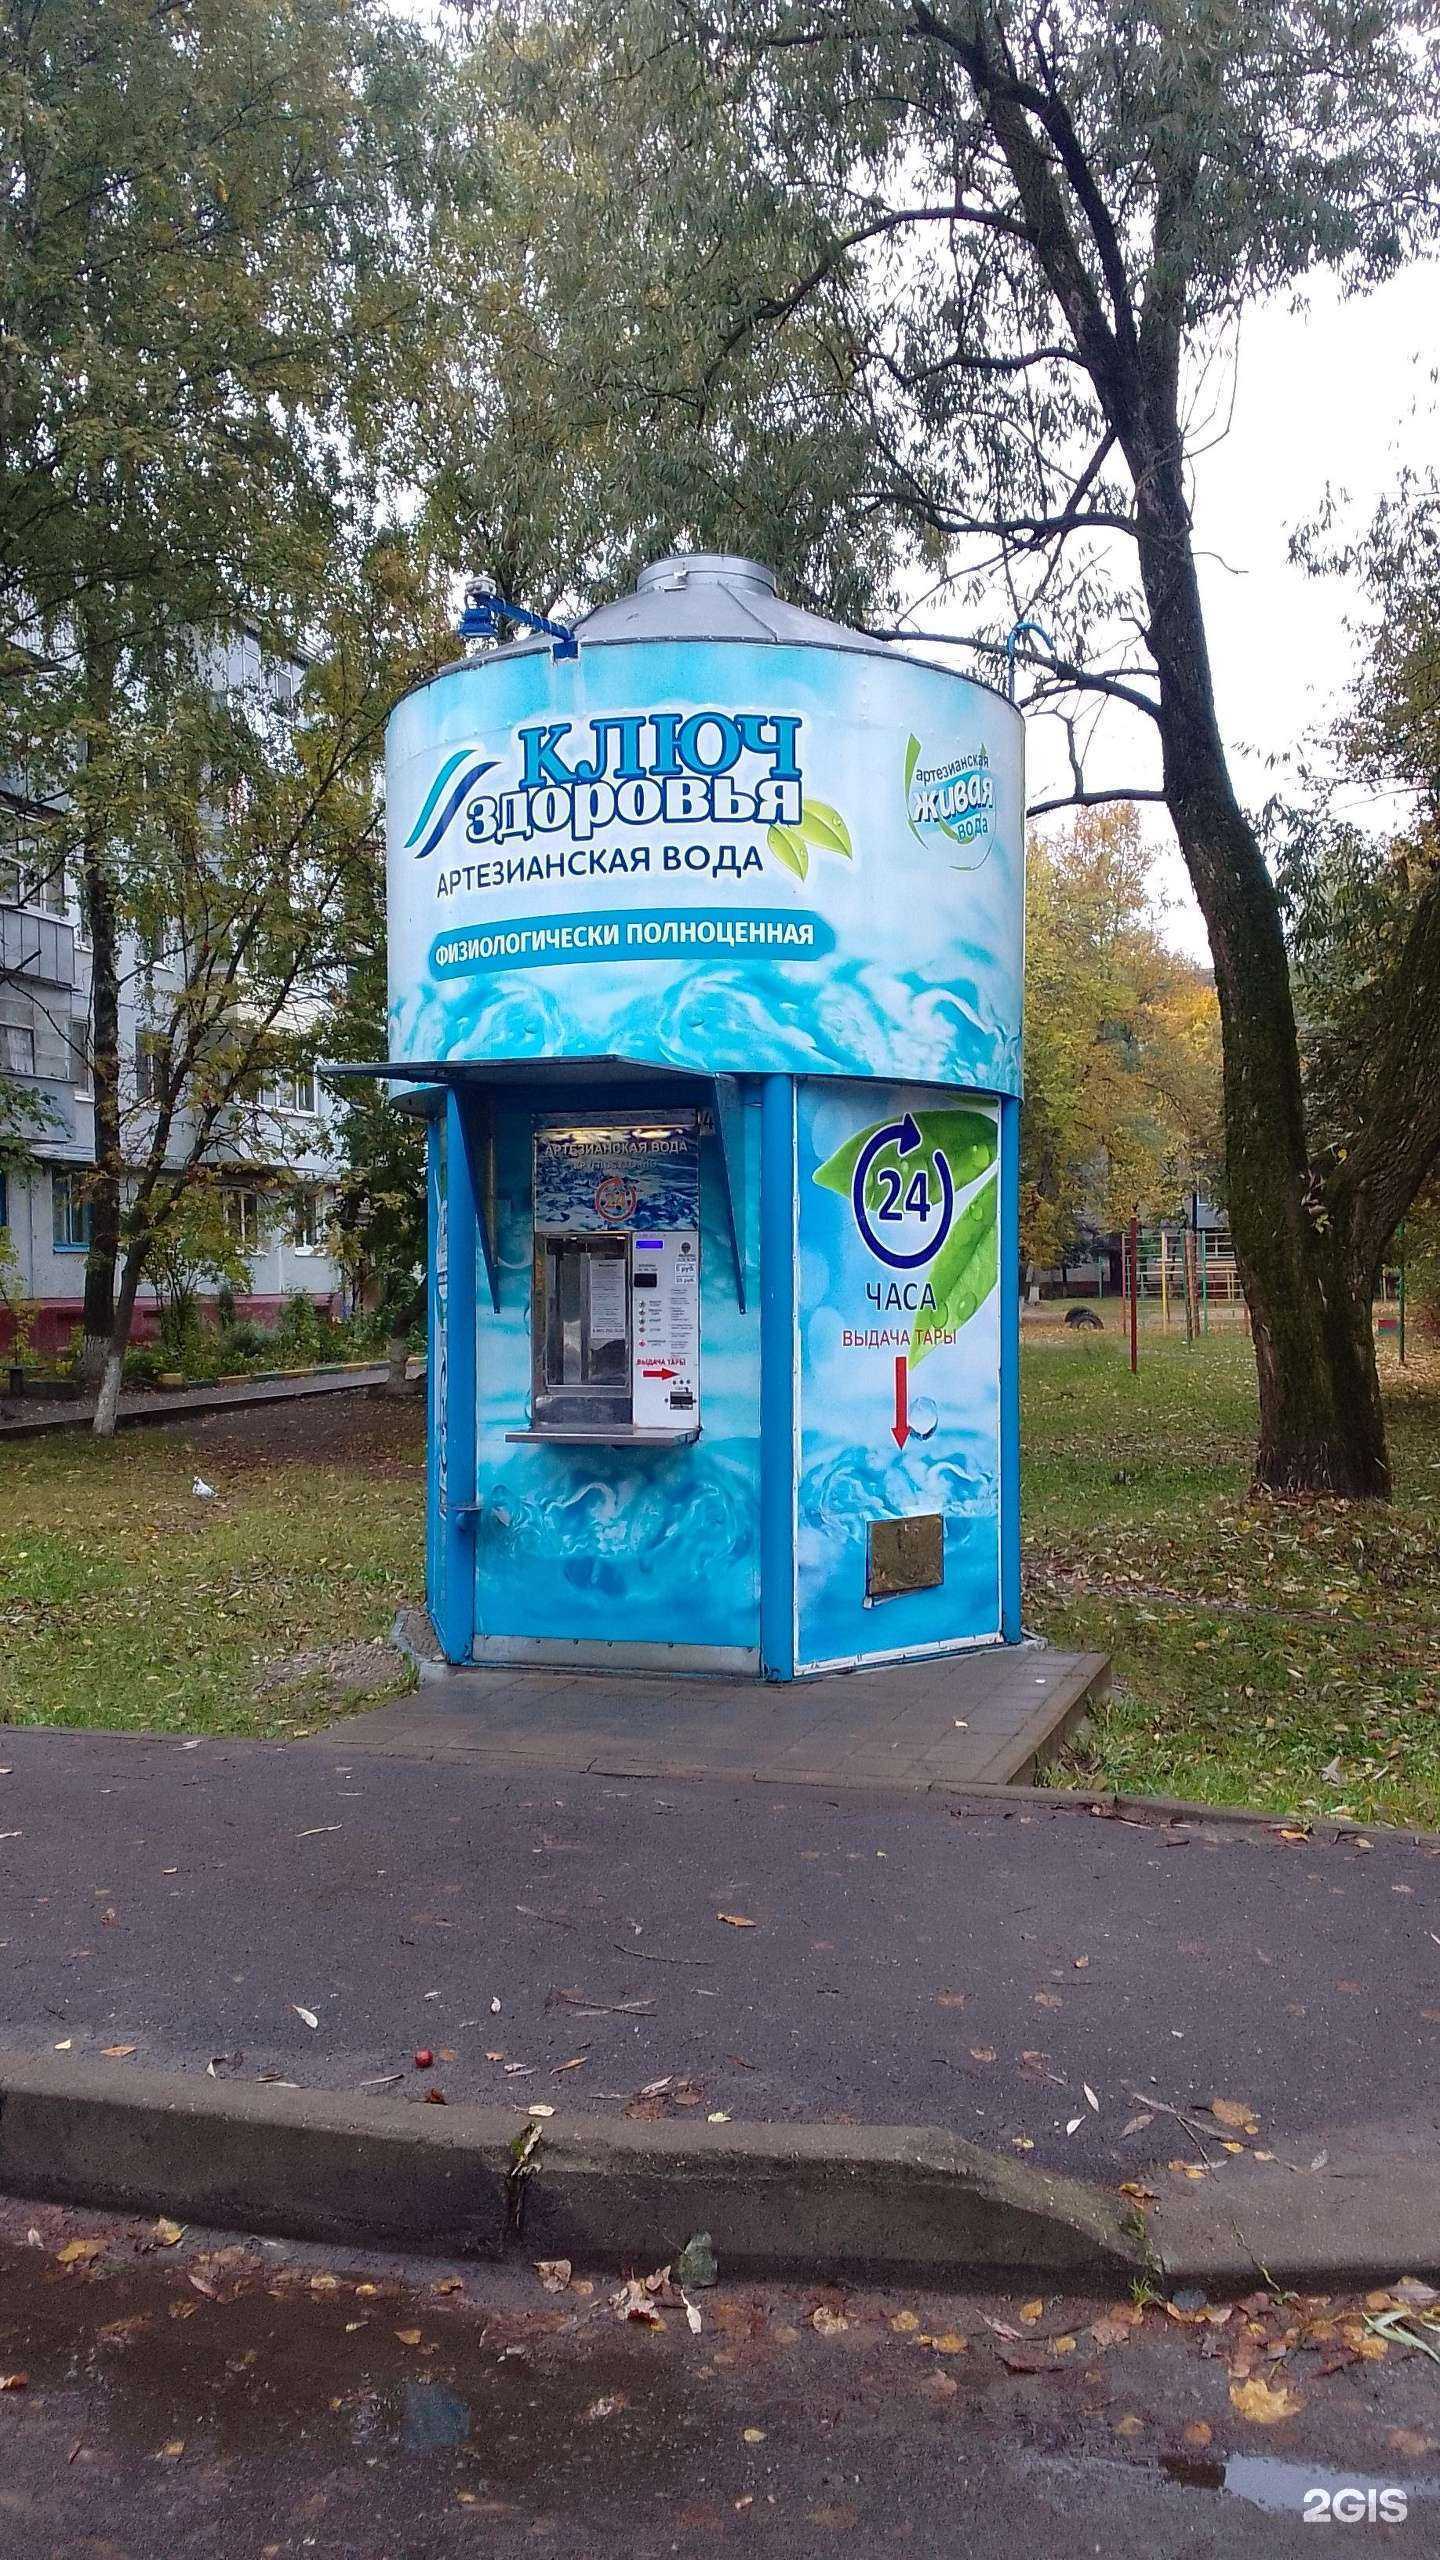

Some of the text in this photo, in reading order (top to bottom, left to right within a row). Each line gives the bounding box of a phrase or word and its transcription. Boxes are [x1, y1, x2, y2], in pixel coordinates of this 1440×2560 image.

[518, 712, 803, 788] КЛЮЧ
[916, 755, 989, 786] артезианская
[465, 776, 803, 844] здоровья
[957, 816, 989, 841] вода
[436, 845, 763, 899] АРТЕЗИАНСКАЯ ВОДА
[434, 920, 815, 966] ФИЗИОЛОГИЧЕСКИ ПОЛНОЦЕННАЯ
[545, 1141, 688, 1158] АРТЕЗИАНСКАЯ ВОДА
[877, 1168, 931, 1222] 24
[866, 1282, 936, 1311] ЧАСА
[842, 1328, 957, 1348] ВЫДАЧА ТАРЫ
[667, 1358, 686, 1366] ТАРЫ
